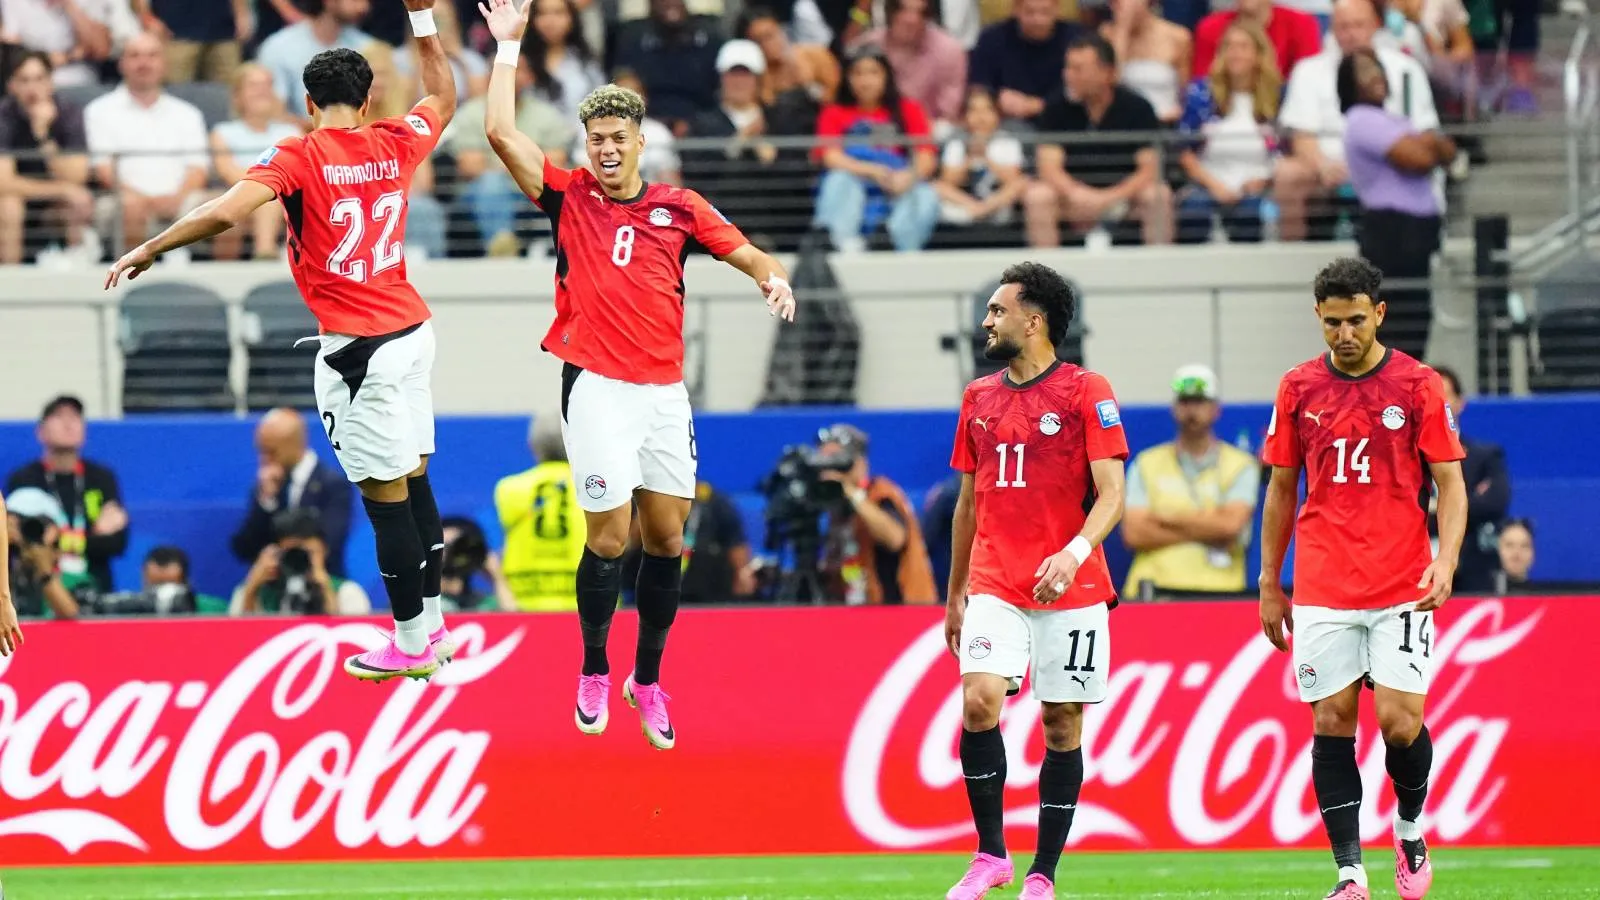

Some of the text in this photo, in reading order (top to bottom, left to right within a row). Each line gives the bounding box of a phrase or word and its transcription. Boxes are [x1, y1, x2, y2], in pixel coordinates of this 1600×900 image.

[323, 159, 399, 185] MARMOUSH
[326, 190, 404, 283] 22
[612, 225, 635, 267] 8
[995, 443, 1027, 488] 11
[1332, 437, 1371, 484] 14
[1063, 629, 1097, 673] 11
[1398, 610, 1430, 658] 14
[0, 622, 527, 853] ca-Cola
